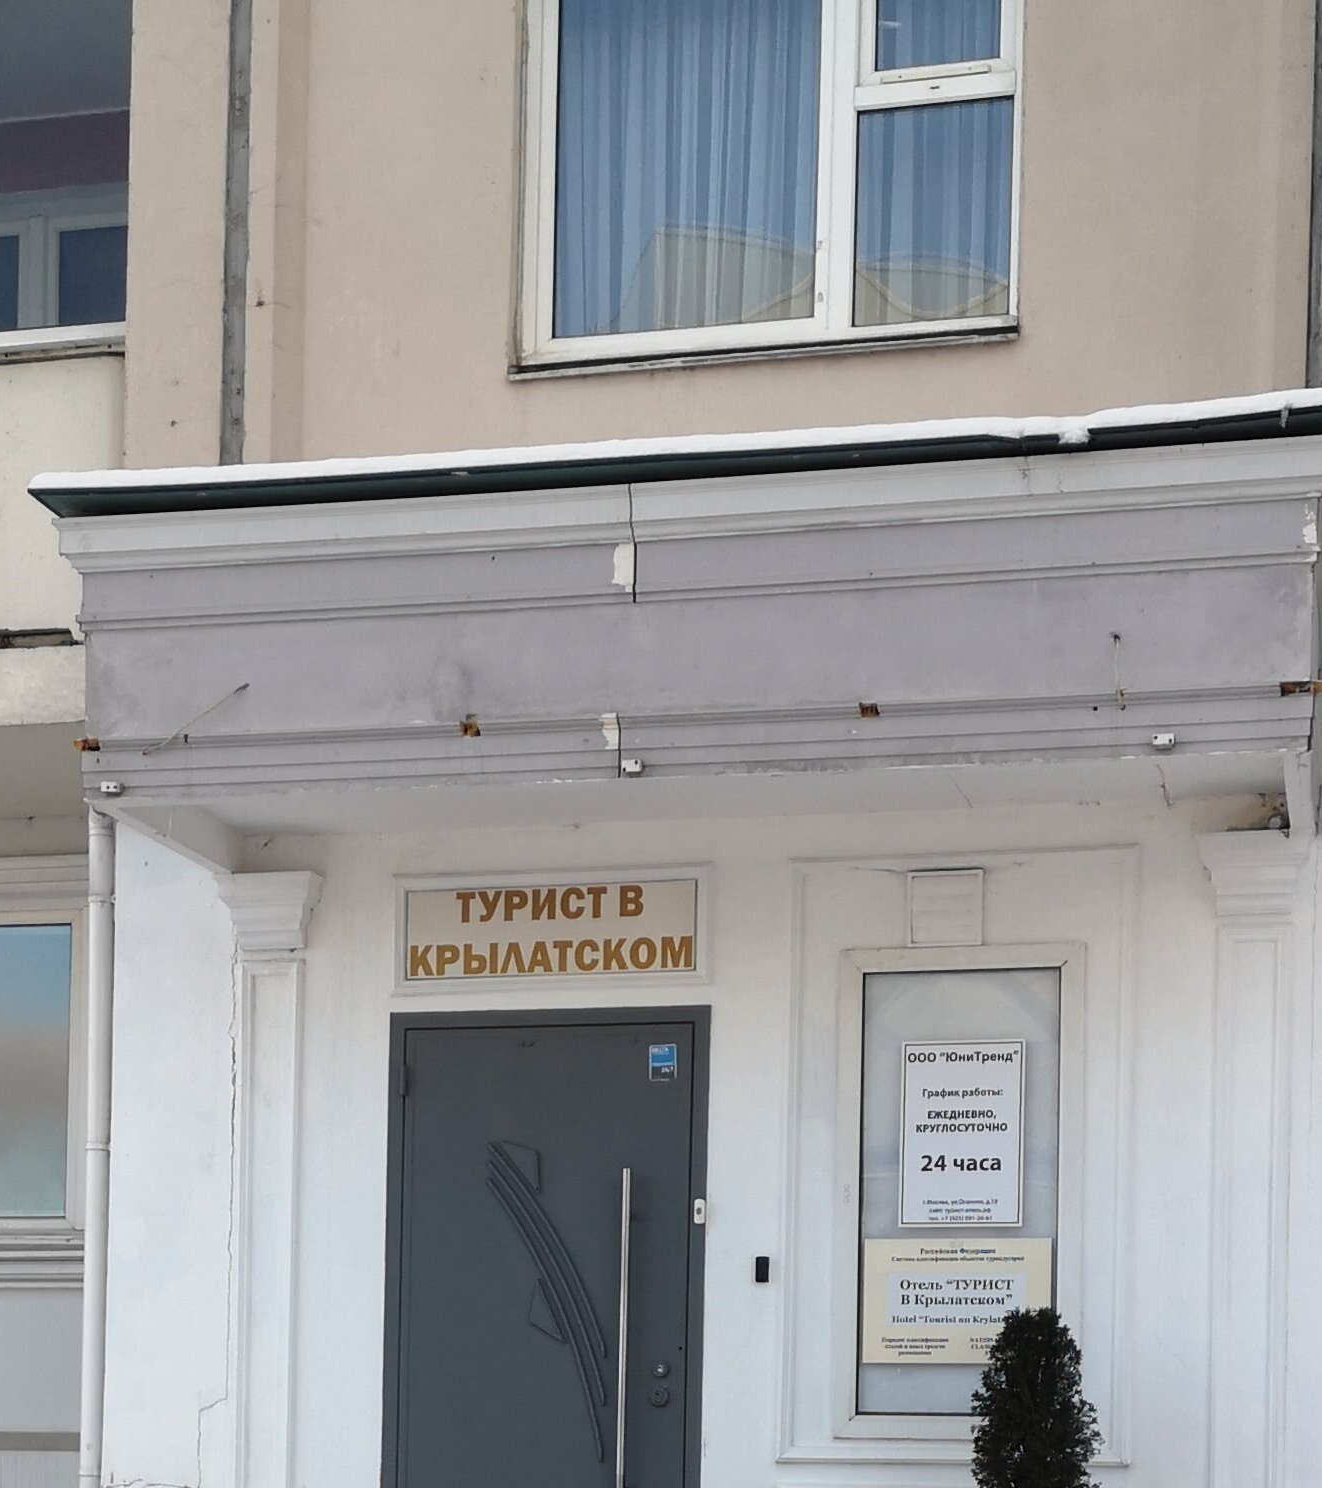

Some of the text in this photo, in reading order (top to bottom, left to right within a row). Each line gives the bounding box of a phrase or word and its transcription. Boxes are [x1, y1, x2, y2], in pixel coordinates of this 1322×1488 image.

[456, 884, 644, 923] ТУРИСТ В
[409, 935, 693, 977] КРЫЛАТСКОМ
[907, 1052, 937, 1063] ООО
[922, 1088, 1004, 1099] График работы:
[927, 1110, 997, 1120] ЕЖЕДНЕВНО,
[915, 1122, 1008, 1133] КРУГЛОСУТОЧНО
[920, 1154, 1002, 1172] 24 часа
[899, 1279, 943, 1291] Отель
[901, 1294, 910, 1305] В
[892, 1315, 917, 1323] Hotel
